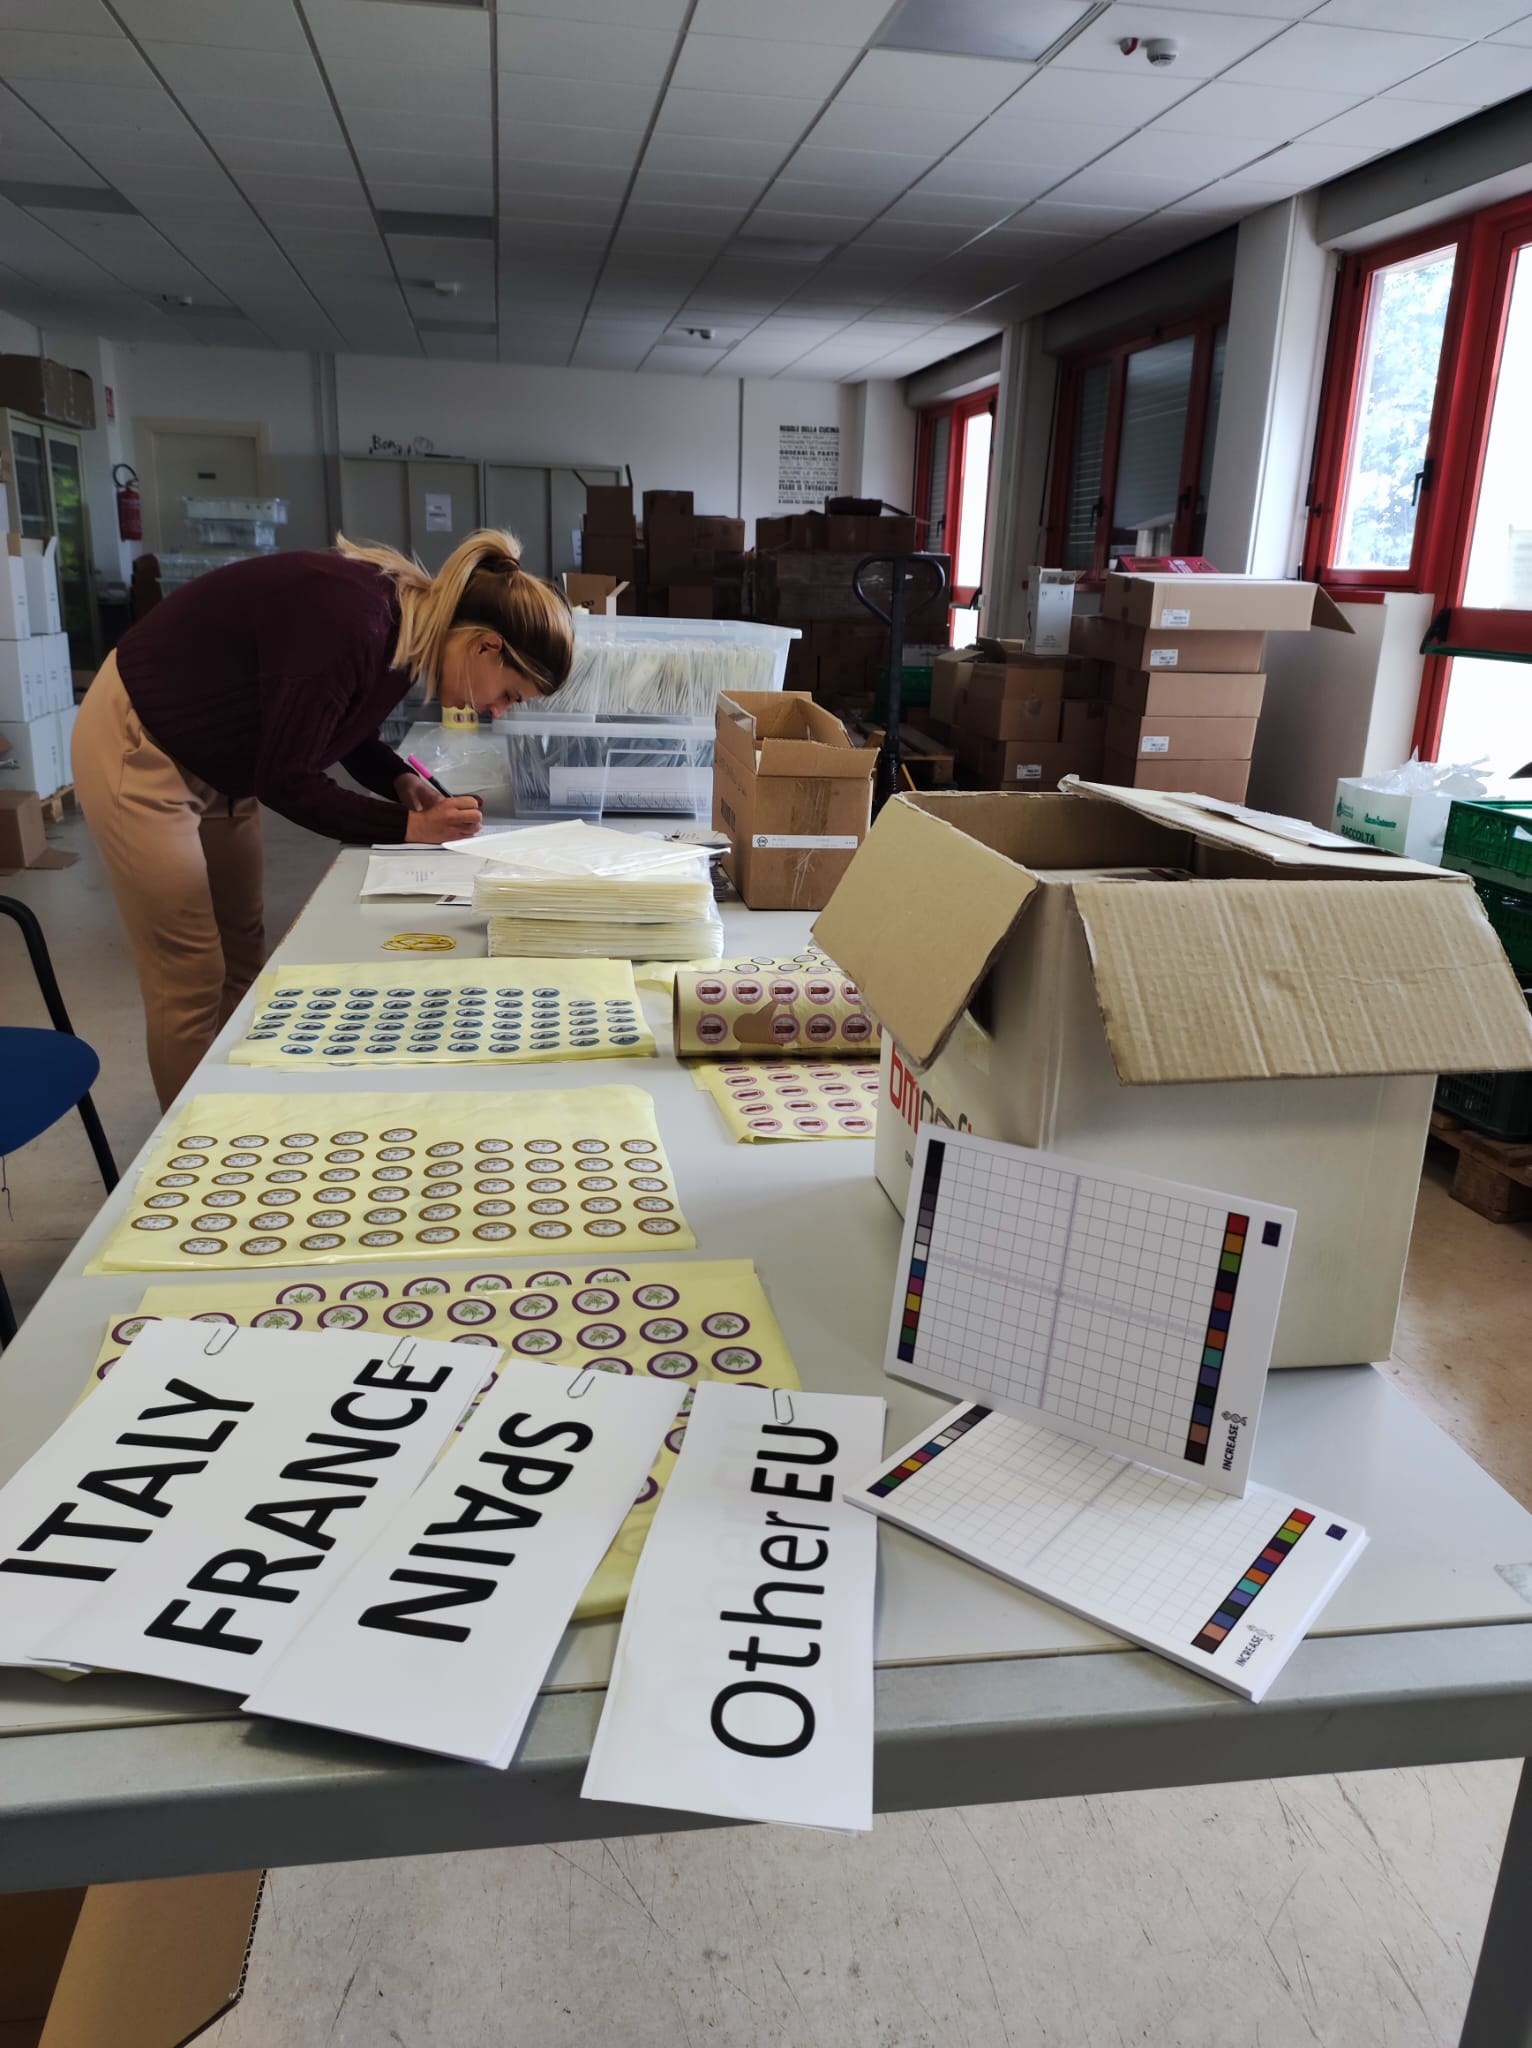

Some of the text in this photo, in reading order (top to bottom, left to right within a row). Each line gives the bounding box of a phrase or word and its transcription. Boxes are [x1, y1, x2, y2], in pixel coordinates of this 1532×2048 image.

[0, 1378, 254, 1582] ITALY
[144, 1358, 454, 1656] FRANCE
[359, 1412, 594, 1643] SPAIN
[1222, 1423, 1239, 1471] INCREASE
[710, 1423, 839, 1759] Other EU
[1235, 1634, 1264, 1667] INCREASE
